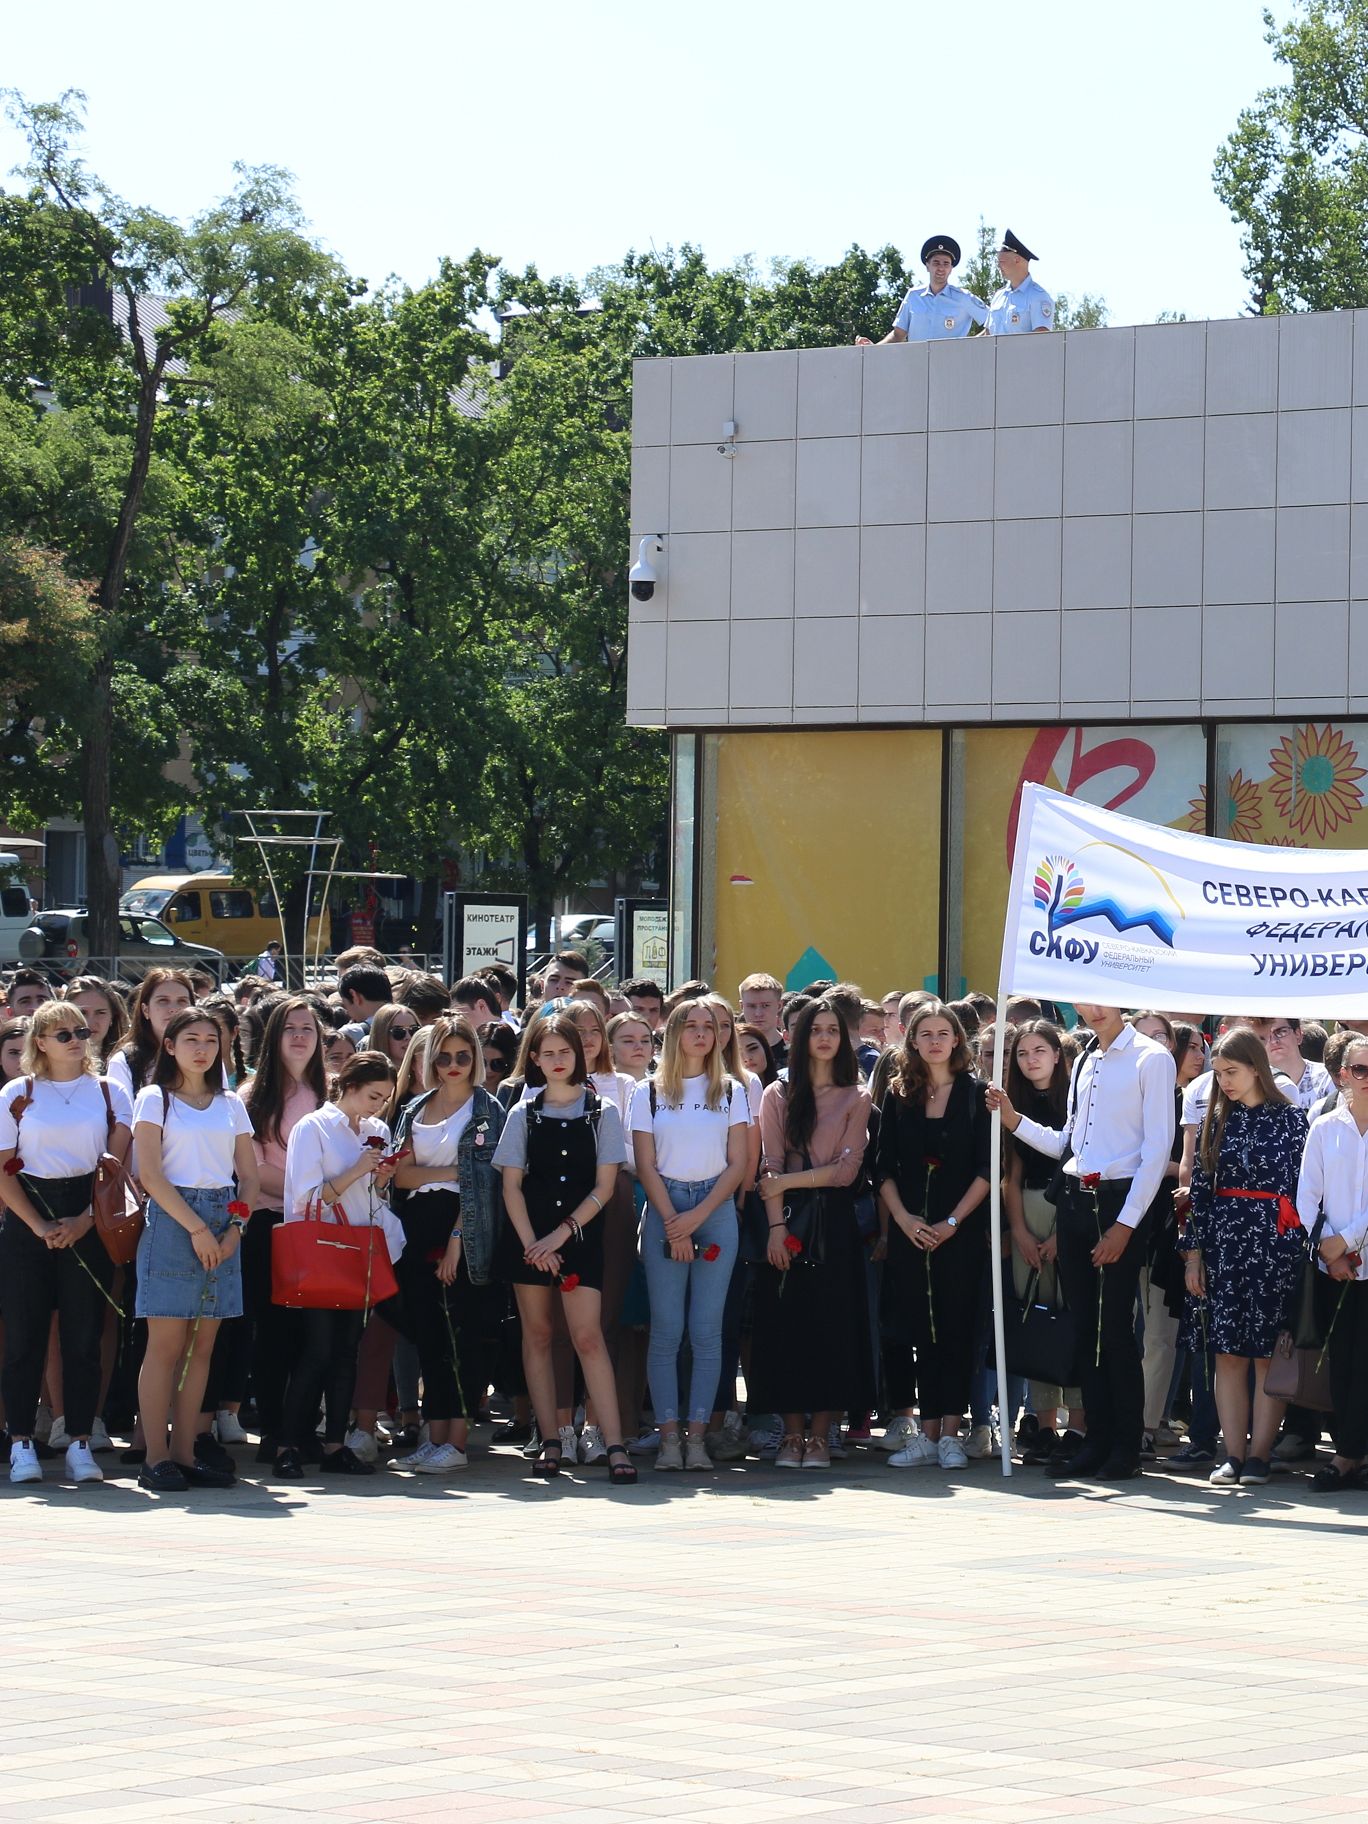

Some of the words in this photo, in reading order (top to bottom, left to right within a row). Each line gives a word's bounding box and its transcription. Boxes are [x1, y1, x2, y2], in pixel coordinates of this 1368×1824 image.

[466, 913, 515, 923] КИНОТЕАТР
[465, 947, 499, 956] ЭТАЖИ
[1029, 930, 1099, 964] СКФУ
[1103, 951, 1155, 964] ФЕДЕРАЛЬНЫЙ
[1100, 960, 1151, 973] УНИВЕРСИТЕТ
